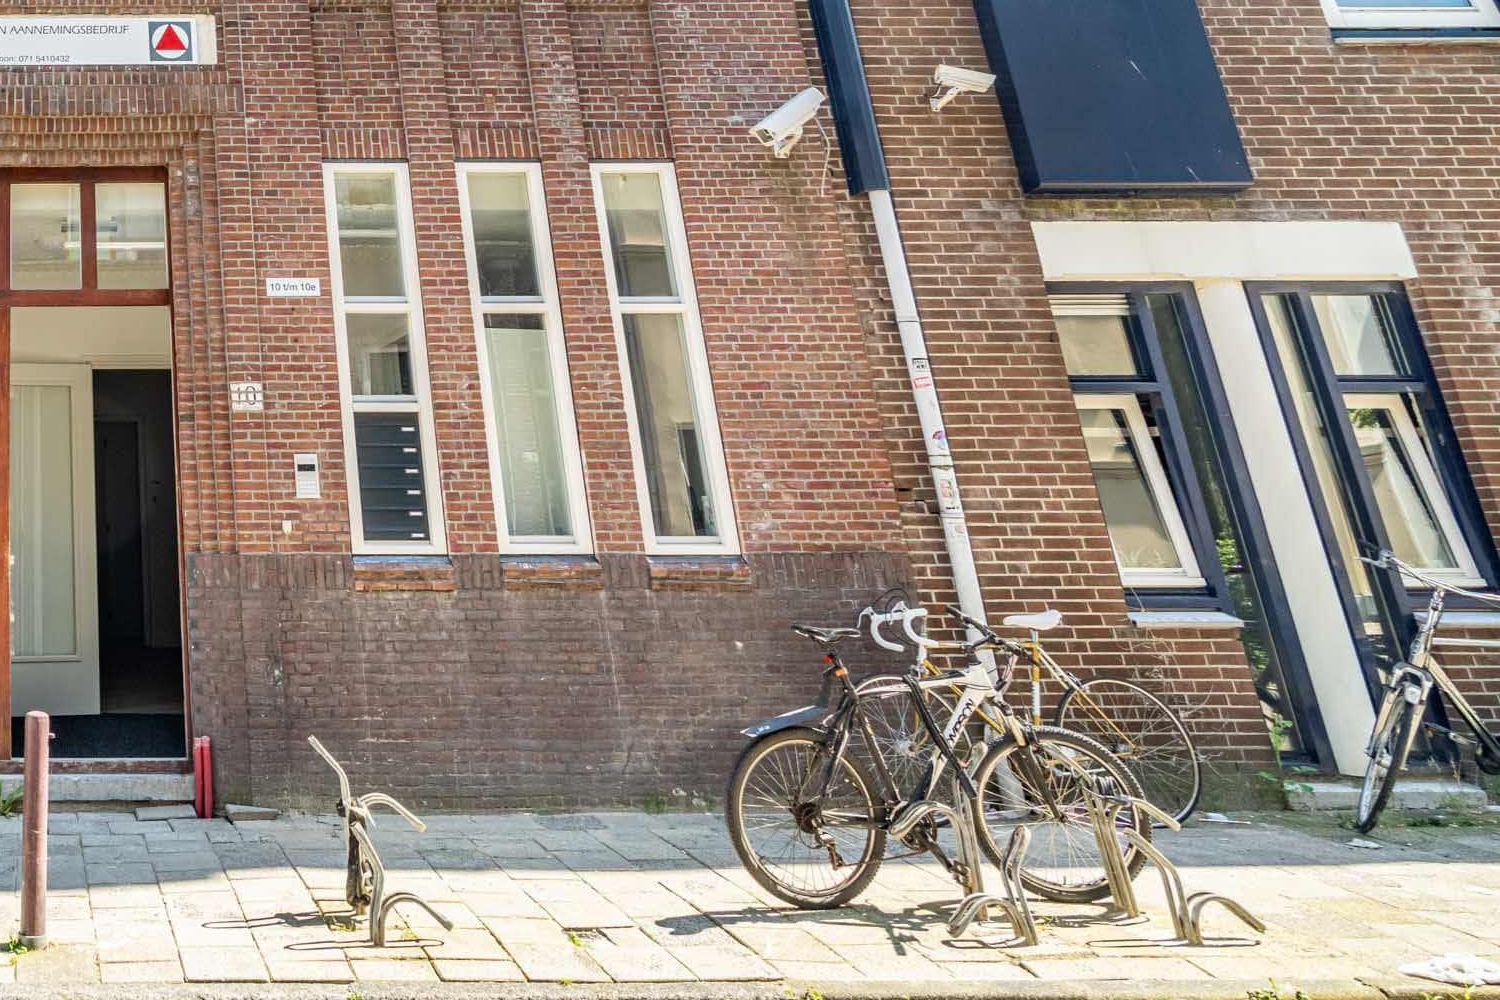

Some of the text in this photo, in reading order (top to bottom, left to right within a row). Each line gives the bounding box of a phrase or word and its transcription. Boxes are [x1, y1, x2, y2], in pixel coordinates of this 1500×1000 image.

[9, 25, 130, 35] AANNEMINGSBEDRIJF
[18, 55, 33, 63] 071
[35, 55, 70, 63] 5410432
[270, 282, 316, 291] 10 t/m 10e
[235, 385, 256, 406] 10
